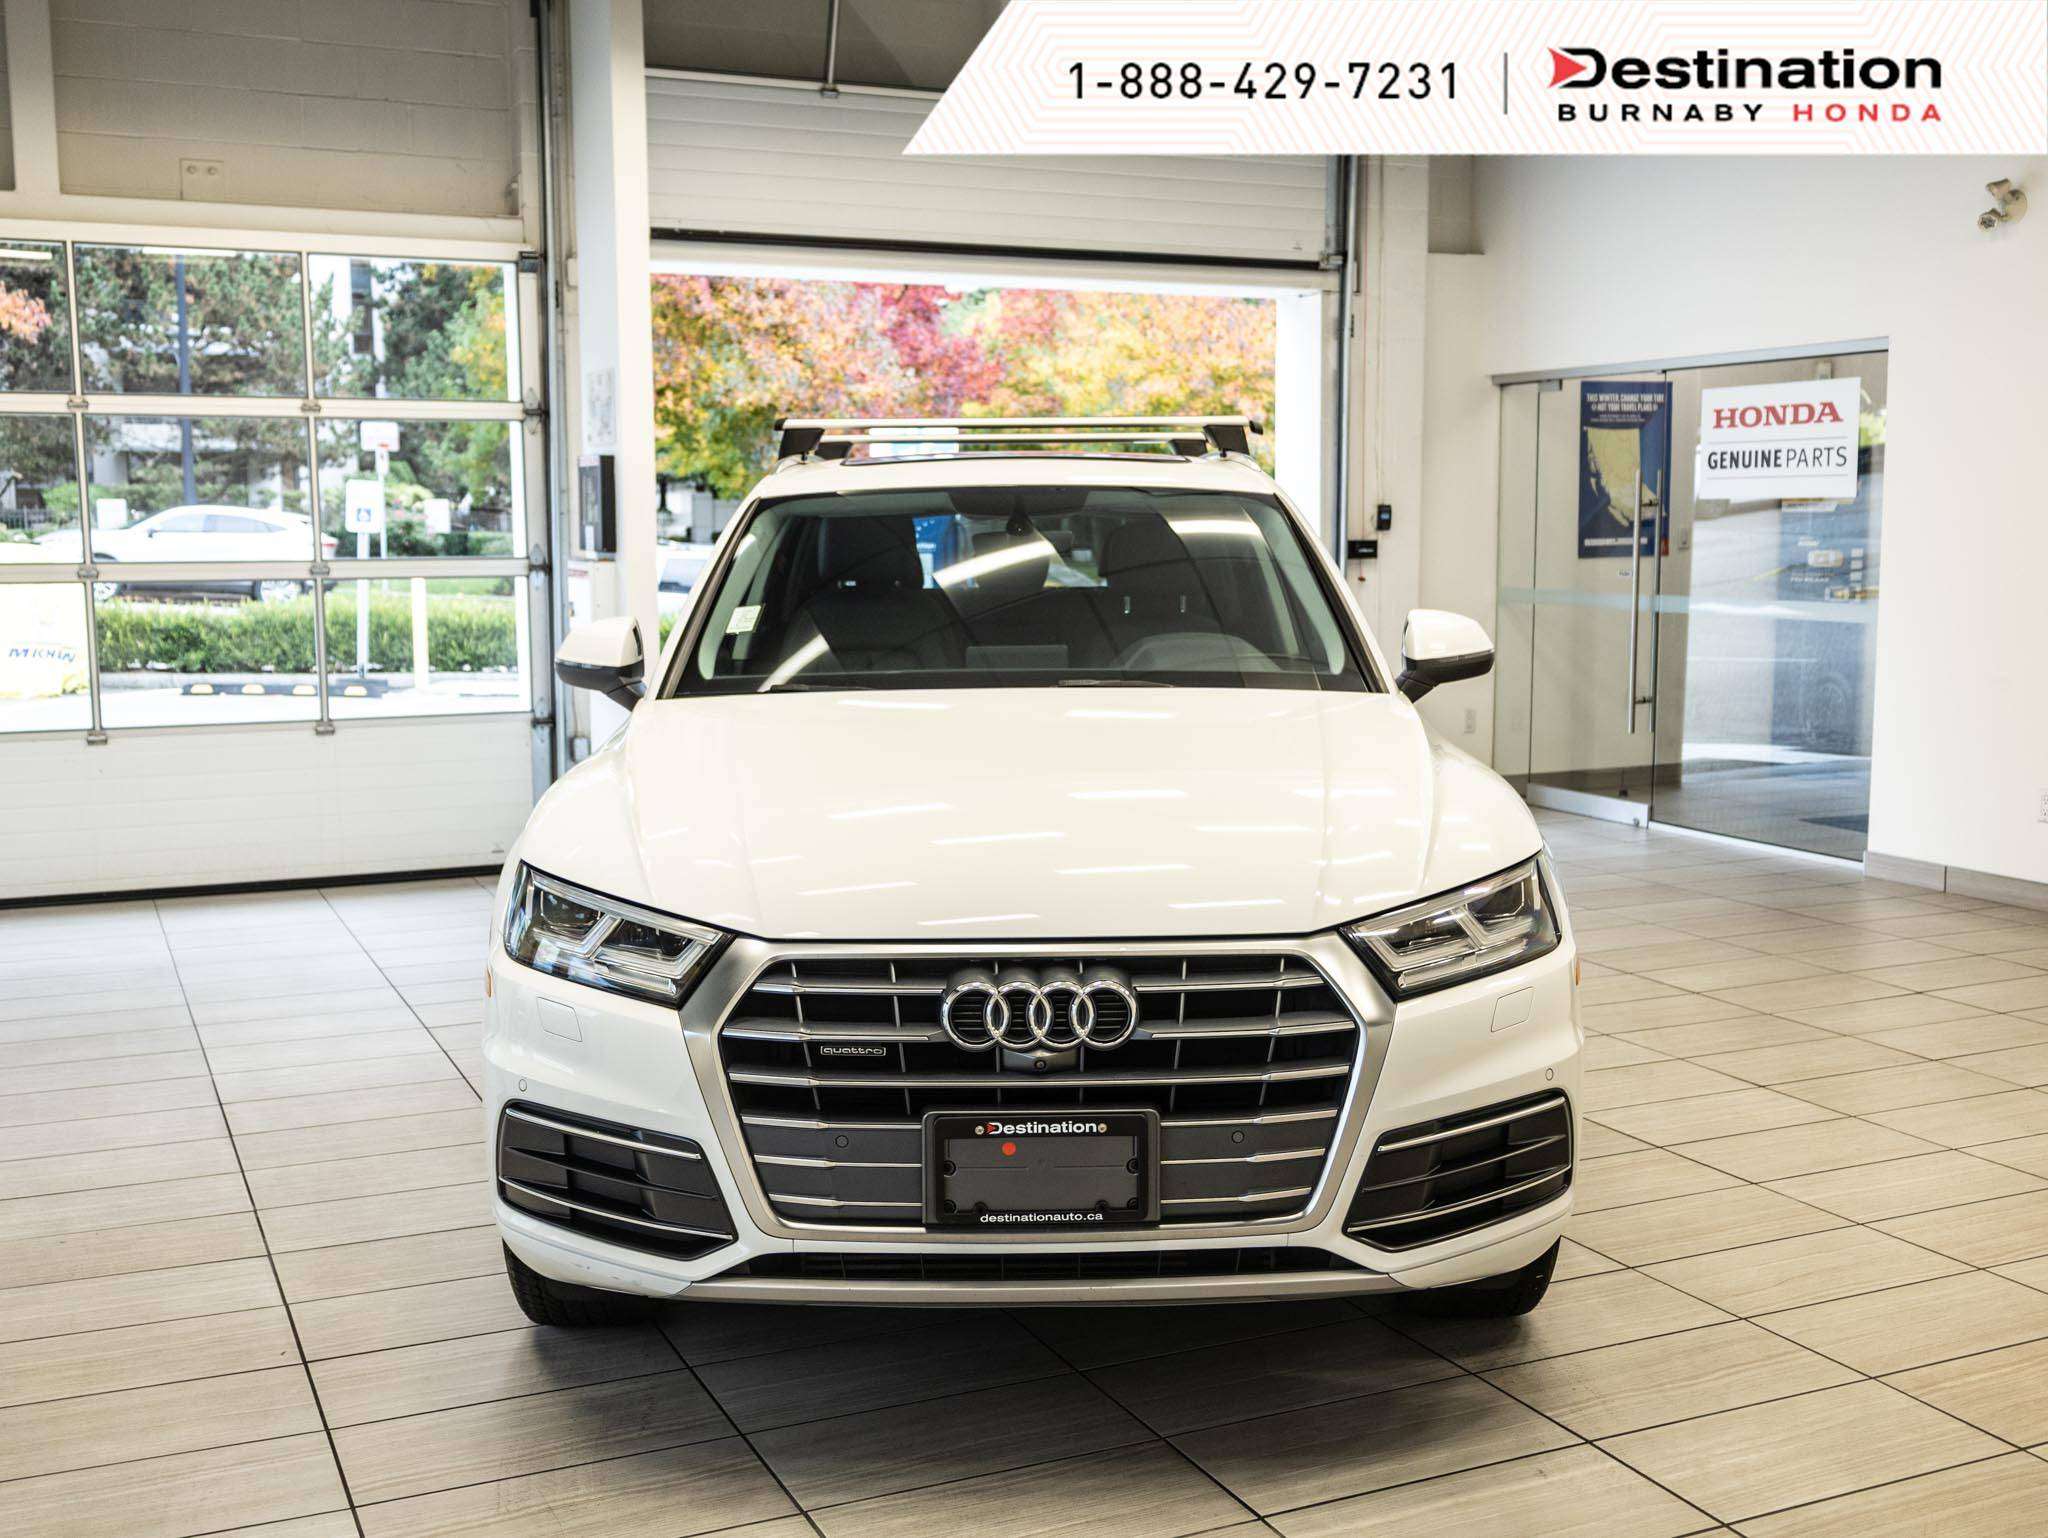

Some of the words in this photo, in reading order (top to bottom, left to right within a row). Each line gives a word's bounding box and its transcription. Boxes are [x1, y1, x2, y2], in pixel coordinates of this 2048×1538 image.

[1713, 402, 1844, 429] HONDA
[1708, 449, 1782, 470] GENUINE
[1786, 446, 1847, 468] PARTS
[823, 1047, 883, 1055] quattro
[986, 1121, 1097, 1135] Destination
[980, 1212, 1104, 1223] destinationauto.ca
